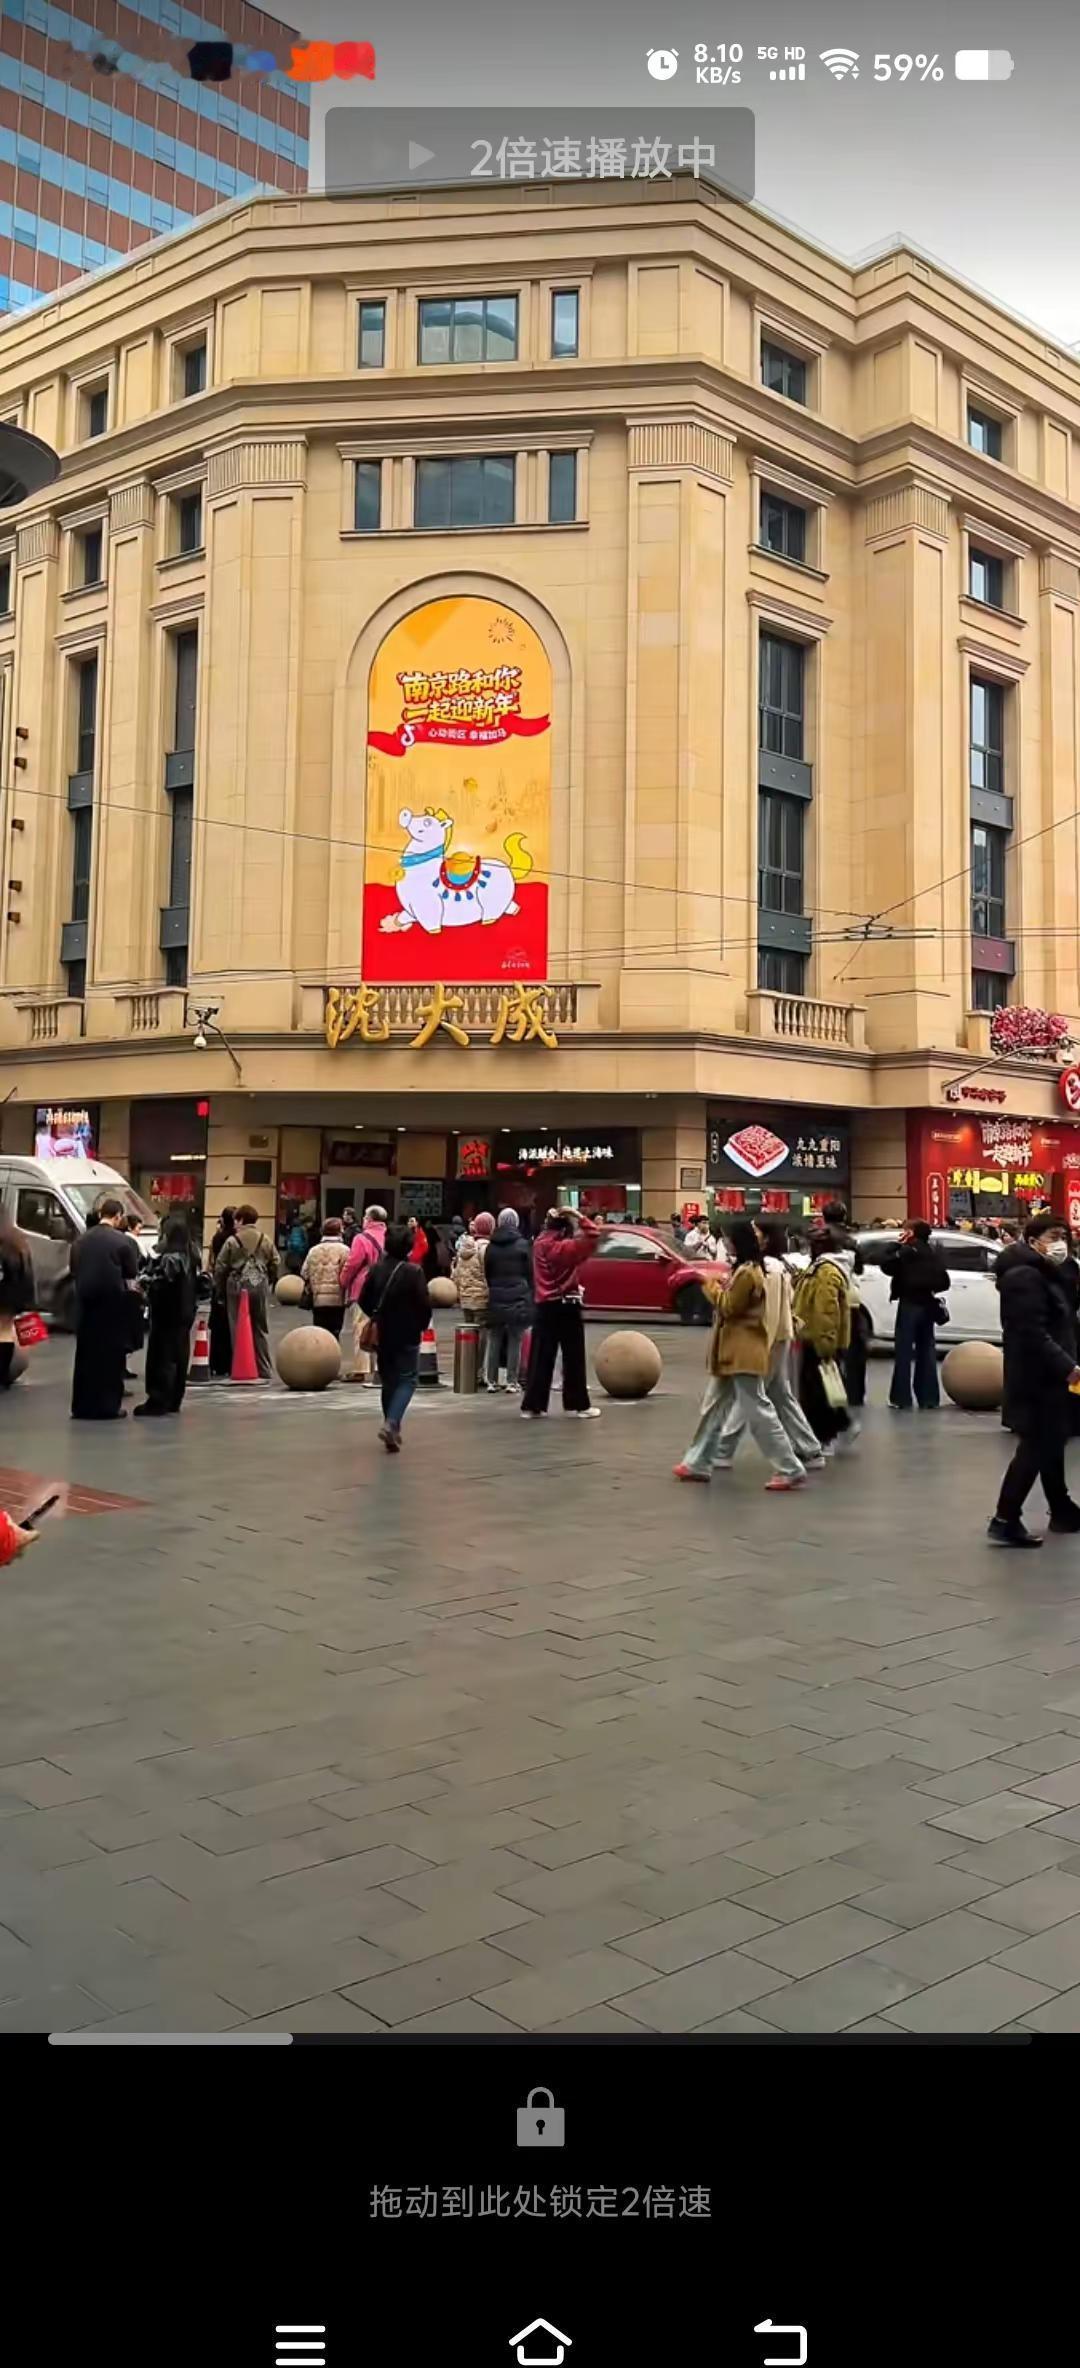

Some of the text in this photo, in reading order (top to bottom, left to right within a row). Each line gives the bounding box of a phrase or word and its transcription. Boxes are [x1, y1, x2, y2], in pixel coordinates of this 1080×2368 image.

[397, 666, 522, 703] 南京路和你
[402, 692, 520, 727] 一起迎新年
[326, 981, 559, 1048] 沈大成
